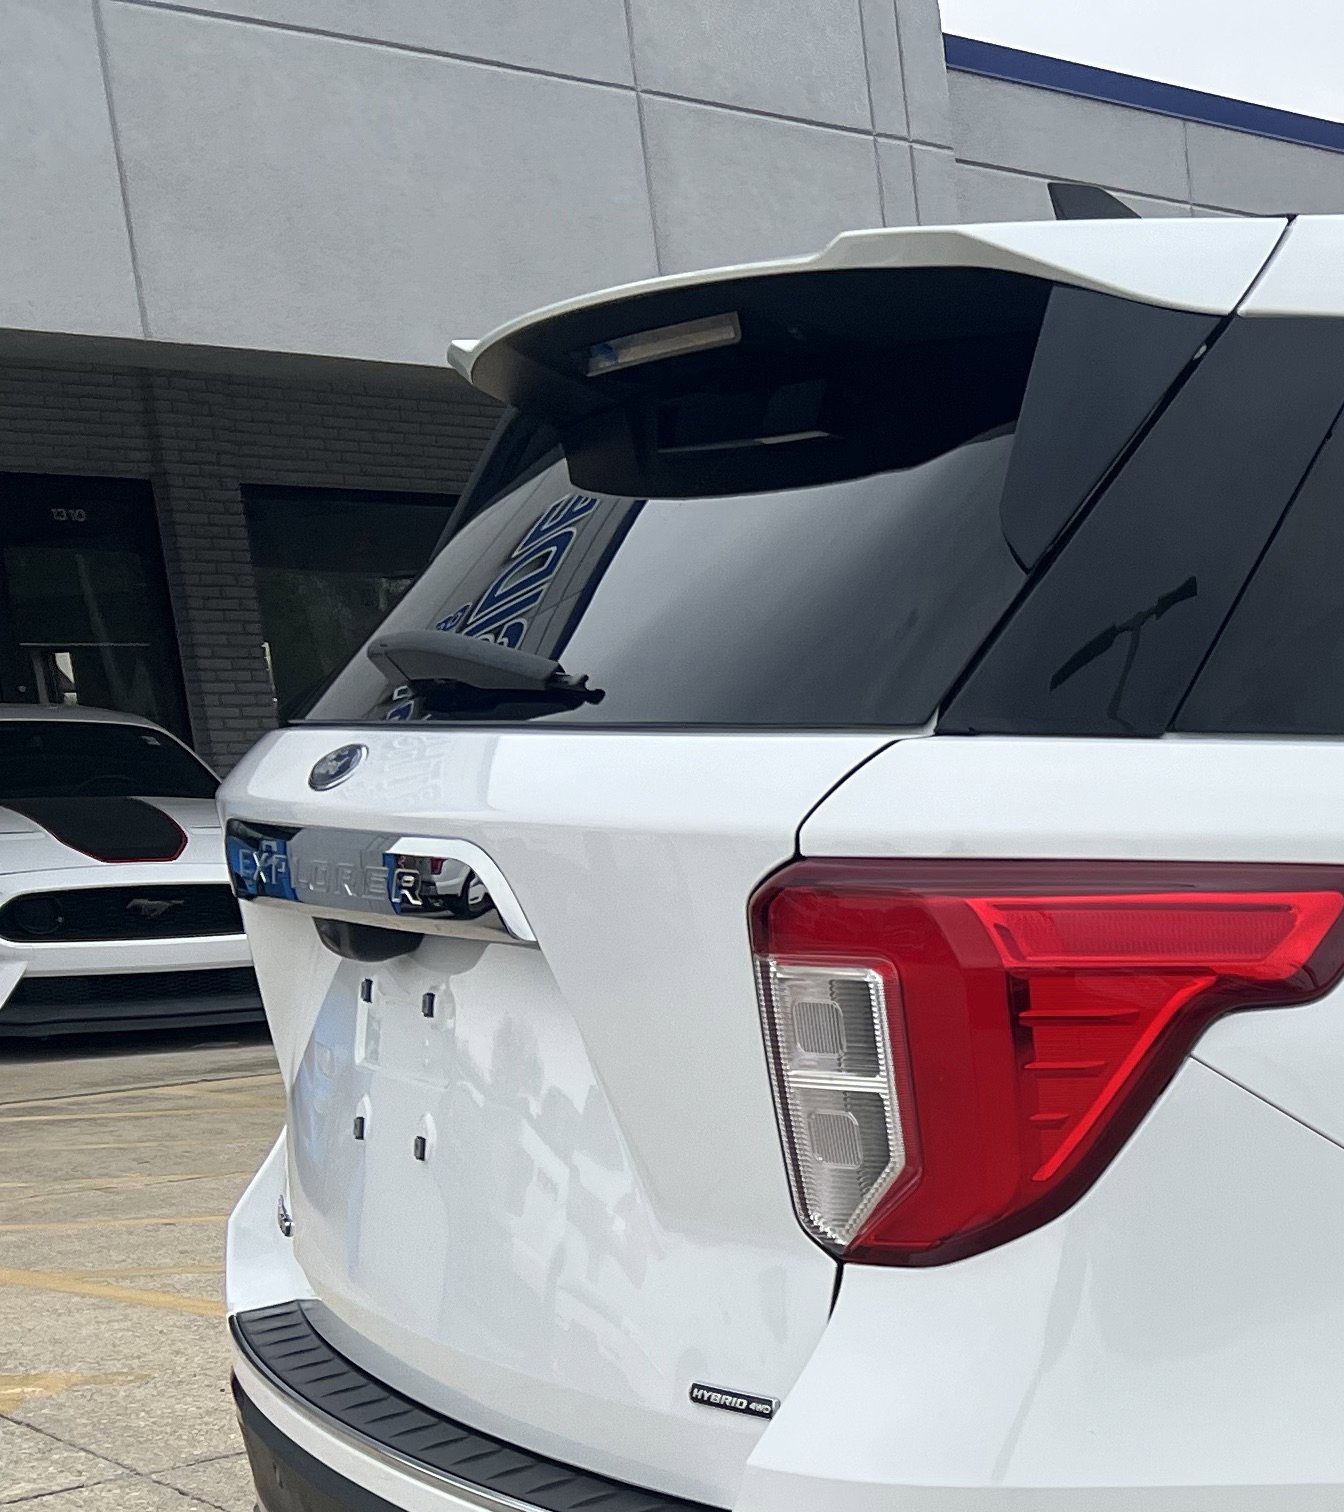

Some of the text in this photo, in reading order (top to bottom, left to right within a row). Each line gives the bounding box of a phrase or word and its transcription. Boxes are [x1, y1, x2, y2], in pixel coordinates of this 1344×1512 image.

[50, 508, 86, 522] 1310
[238, 848, 424, 905] EXPLORER
[692, 1388, 772, 1414] HYBRID 4WD
